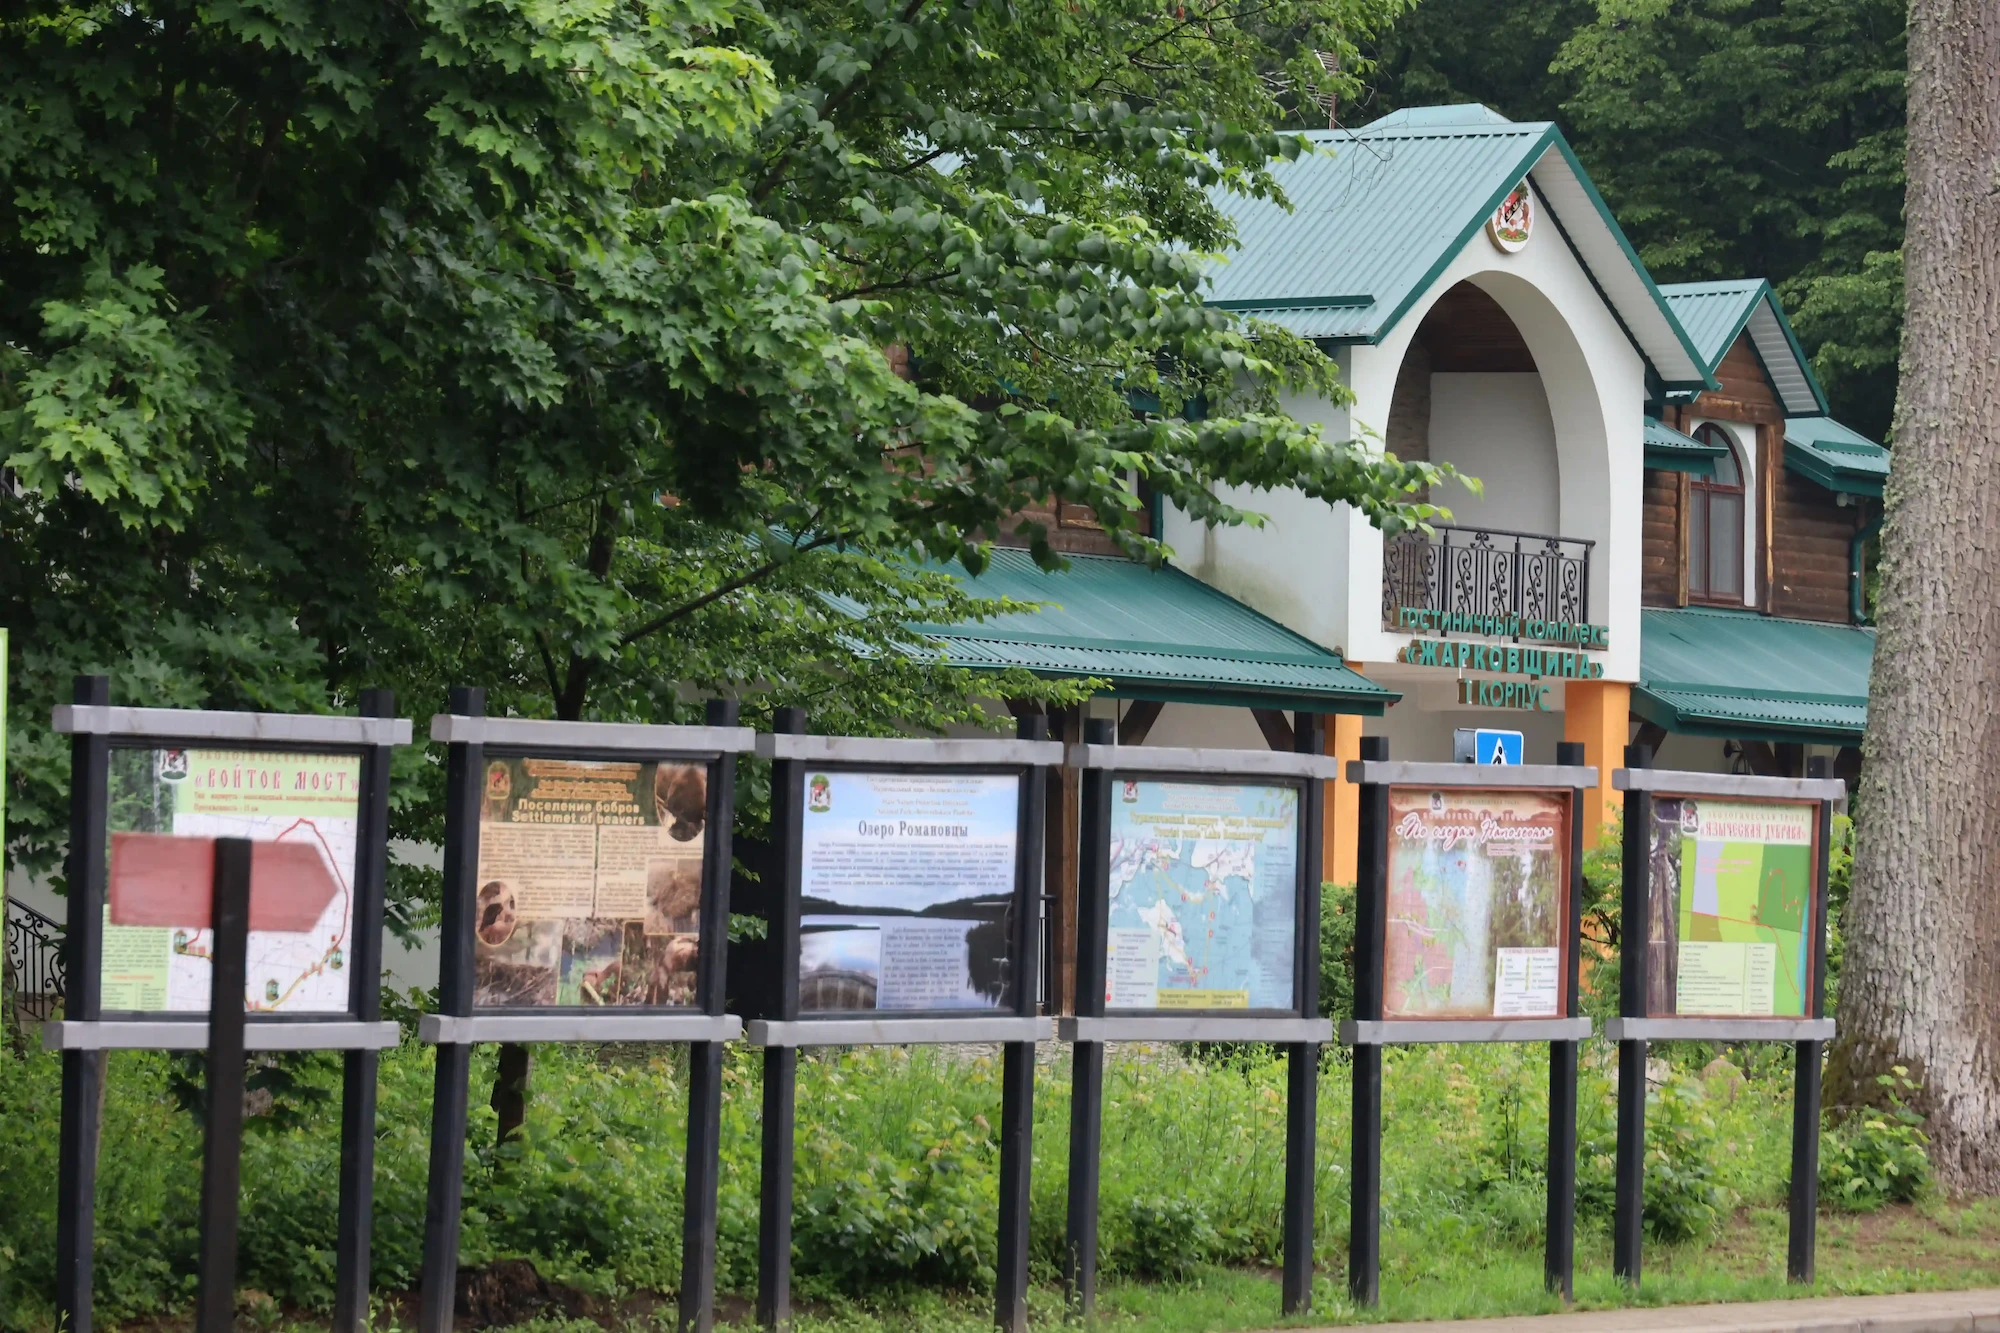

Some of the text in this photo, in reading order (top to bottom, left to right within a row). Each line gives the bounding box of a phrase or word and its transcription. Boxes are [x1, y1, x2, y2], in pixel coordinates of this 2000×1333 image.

[1404, 639, 1605, 680] «ЖАРКОВЩИНА»
[1478, 679, 1551, 712] КОРПУС
[518, 798, 640, 816] Поселение бобров
[512, 810, 645, 826] Settlemet of beavers
[858, 819, 968, 839] Озеро Романовцы
